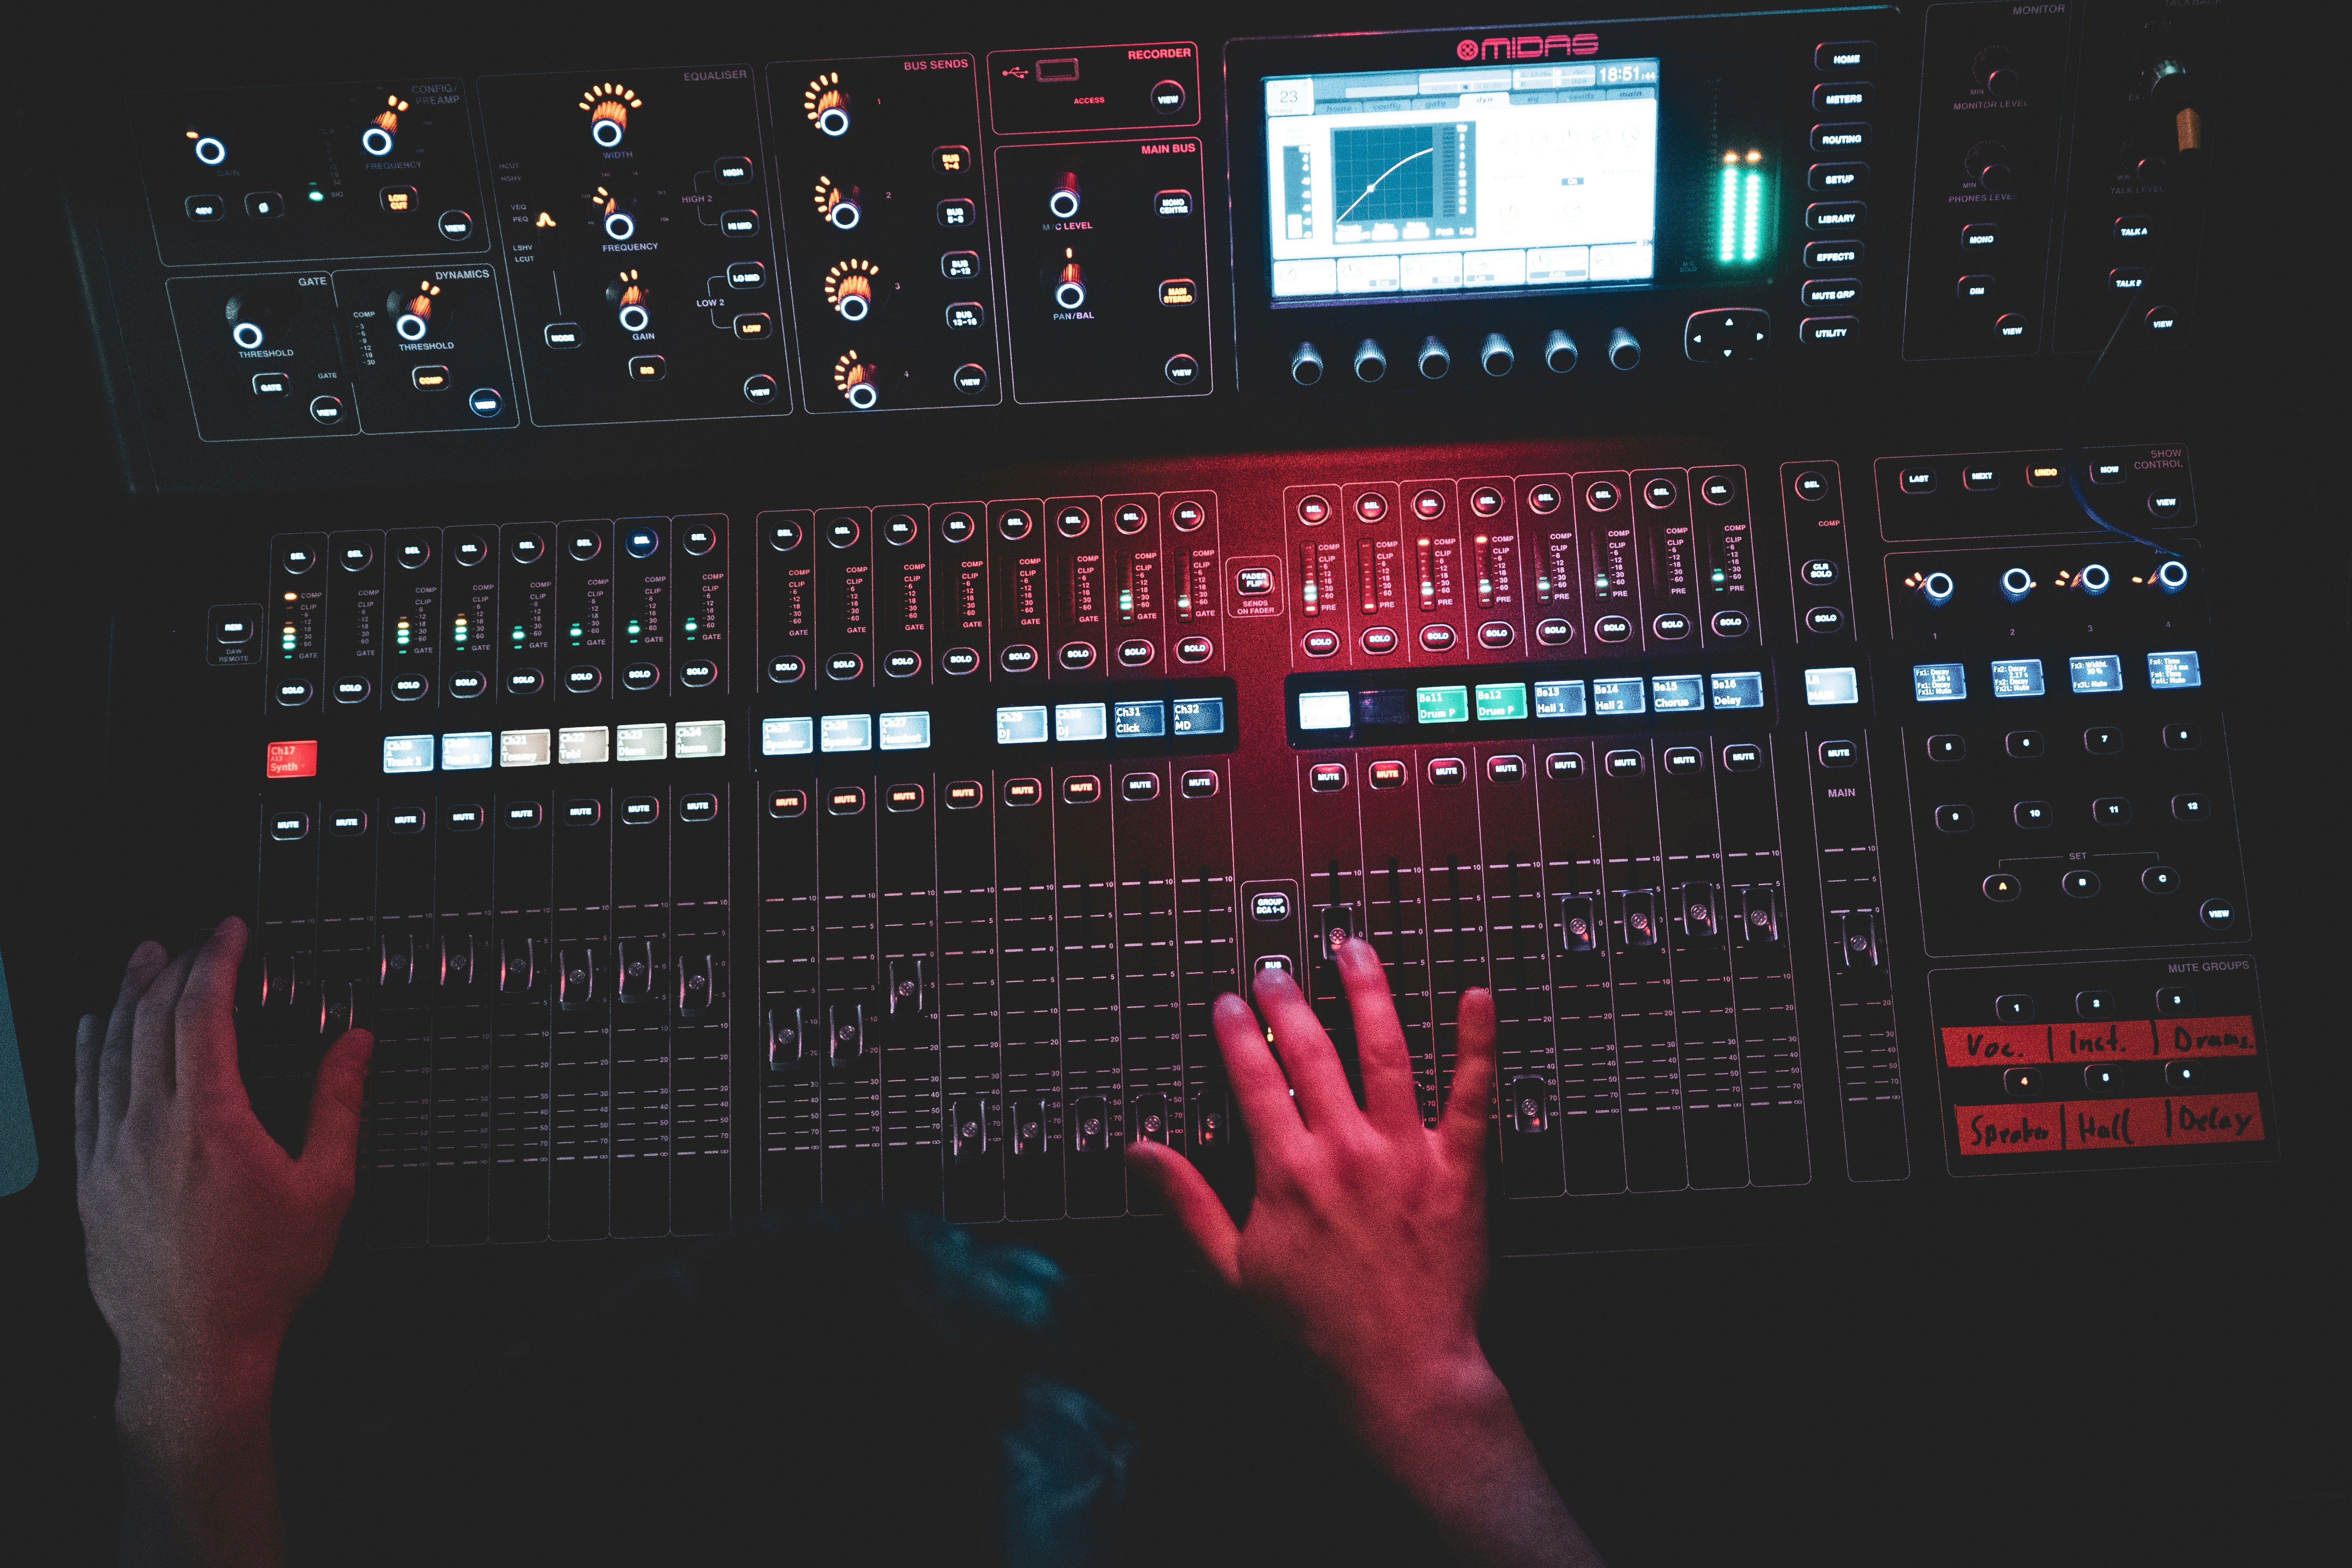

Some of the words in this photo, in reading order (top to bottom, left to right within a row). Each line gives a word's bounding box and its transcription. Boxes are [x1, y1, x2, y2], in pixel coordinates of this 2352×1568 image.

[2013, 4, 2065, 15] MONITOR
[1482, 34, 1598, 60] MIDAS
[1128, 48, 1191, 60] RECORDER
[1833, 54, 1860, 64] HOME
[904, 61, 927, 70] BUS
[930, 59, 968, 69] SENDS
[684, 70, 747, 81] EQUALISER
[416, 95, 459, 104] PREAMP
[1158, 95, 1178, 104] VIEW
[1280, 91, 1297, 103] 23
[1826, 94, 1862, 104] METERS
[1954, 102, 1996, 110] MONITOR
[1822, 134, 1862, 145] ROUTING
[1142, 145, 1169, 154] MAIN
[1172, 143, 1195, 153] BUS
[942, 154, 960, 162] BUS
[365, 161, 421, 169] FREQUENCY
[1826, 175, 1854, 184] SETUP
[1949, 194, 1987, 203] PHONES
[390, 201, 408, 210] CUT
[1818, 214, 1855, 223] LIBRARY
[1969, 236, 1994, 244] MONO
[603, 243, 658, 252] FREQUENCY
[1817, 252, 1855, 261] EFFECTS
[436, 270, 489, 279] DYNAMICS
[299, 277, 327, 286] GATE
[1163, 295, 1192, 303] STEREO
[1812, 291, 1836, 300] MUTE
[1836, 290, 1855, 299] GRP
[743, 325, 761, 333] LOW
[1815, 329, 1847, 338] UTILITY
[399, 342, 454, 350] THRESHOLD
[239, 350, 294, 358] THRESHOLD
[419, 376, 443, 385] COMP
[2151, 449, 2181, 458] SHOW
[2134, 460, 2183, 469] CONTROL
[2034, 468, 2057, 477] UNDO
[1654, 682, 1677, 691] Bs15
[1713, 680, 1736, 689] Bs16
[1537, 688, 1559, 696] Bs13
[1595, 685, 1619, 694] Bs14
[1419, 693, 1442, 702] Bs11
[1478, 691, 1501, 700] Bs12
[1655, 698, 1689, 708] Chorus
[1714, 695, 1741, 706] Delay
[1175, 704, 1199, 714] Ch32
[1538, 703, 1556, 713] Hall
[1559, 703, 1564, 712] 1
[1596, 701, 1615, 710] Hall
[1617, 701, 1624, 710] 2
[1116, 707, 1140, 717] Ch31
[1421, 709, 1446, 718] Drum
[1449, 709, 1455, 717] P
[1479, 707, 1505, 716] Drum
[1508, 706, 1514, 715] P
[1176, 721, 1191, 730] MD
[271, 746, 295, 755] Ch17
[270, 763, 298, 772] Synth
[1828, 788, 1855, 797] MAIN
[2169, 964, 2199, 973] MUTE
[2202, 961, 2249, 971] GROUPS
[1968, 1033, 2024, 1058] Voc.
[2180, 1105, 2252, 1136] Delay
